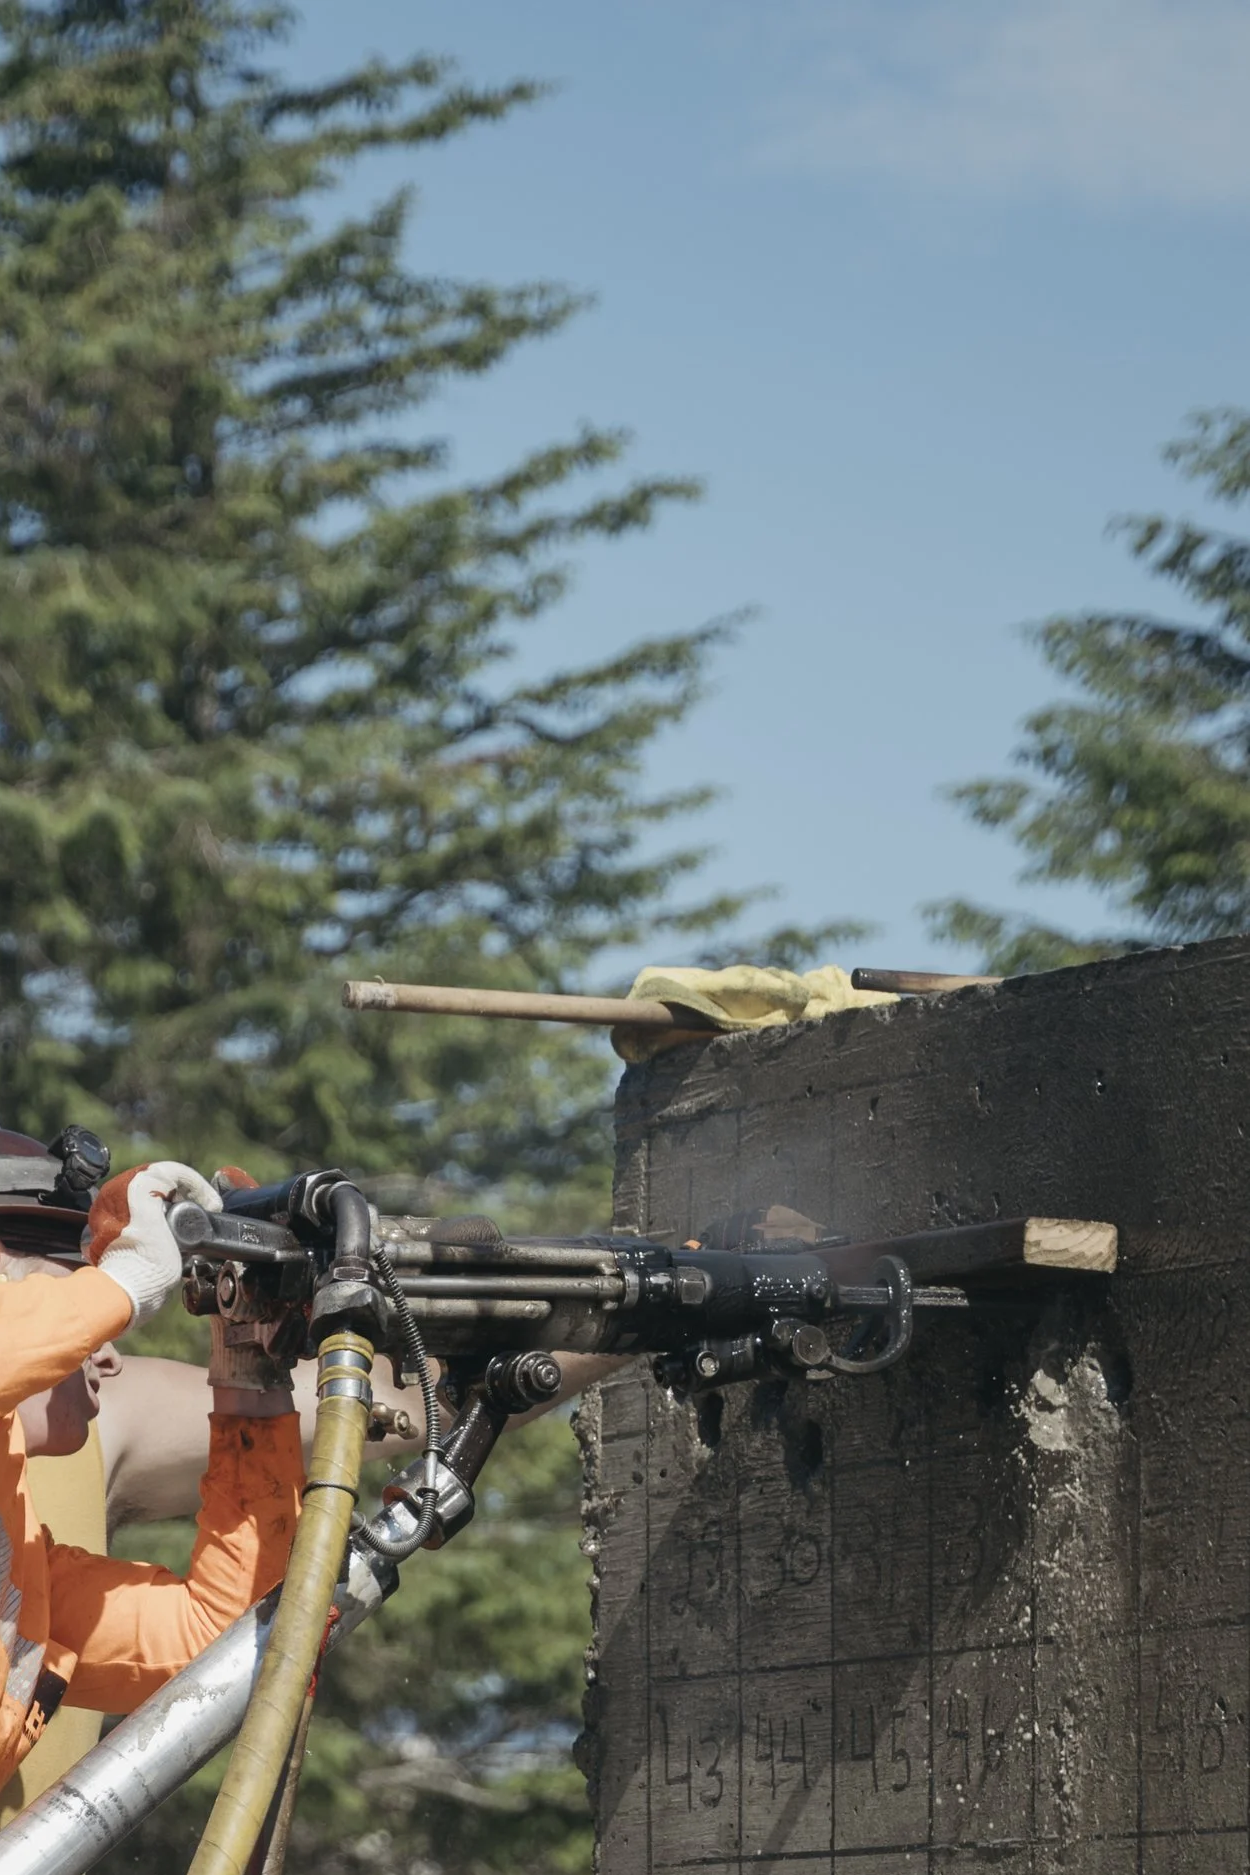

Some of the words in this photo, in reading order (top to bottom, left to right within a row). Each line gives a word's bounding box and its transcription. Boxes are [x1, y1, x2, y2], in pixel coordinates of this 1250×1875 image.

[657, 1702, 724, 1812] 43
[754, 1711, 810, 1800] 44
[849, 1703, 912, 1793] 45
